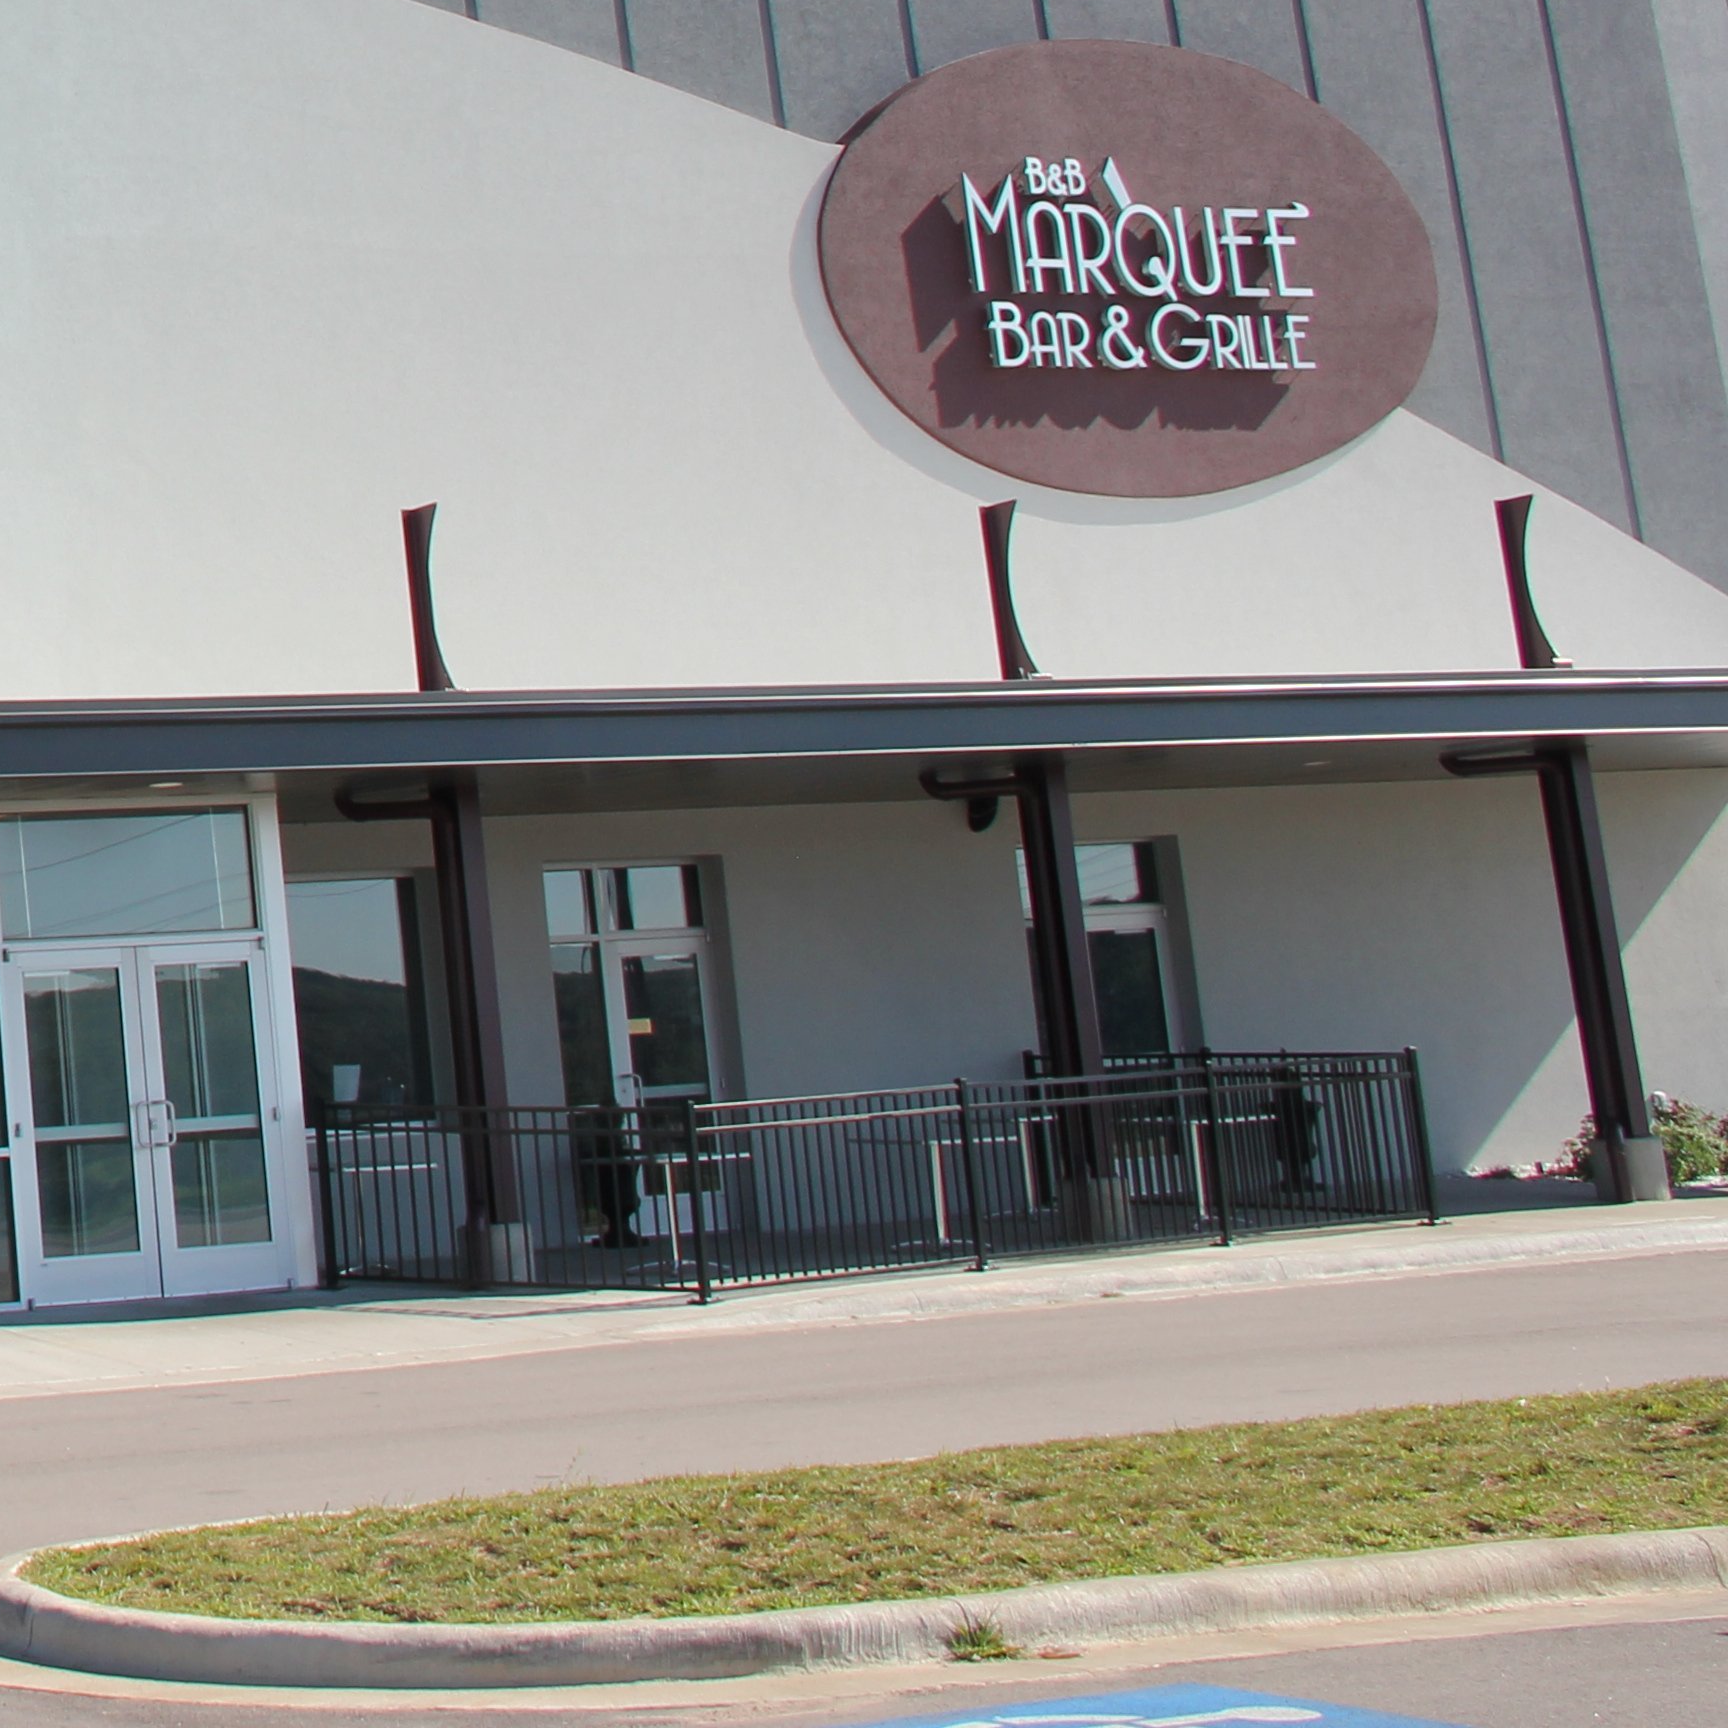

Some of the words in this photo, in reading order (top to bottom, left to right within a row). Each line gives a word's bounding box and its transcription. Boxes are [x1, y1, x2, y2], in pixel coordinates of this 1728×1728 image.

[1025, 156, 1086, 196] B&B
[961, 170, 1314, 301] MARQUEE
[988, 301, 1093, 368] BAR
[1100, 304, 1148, 370] &
[1150, 303, 1317, 370] GRILLE
